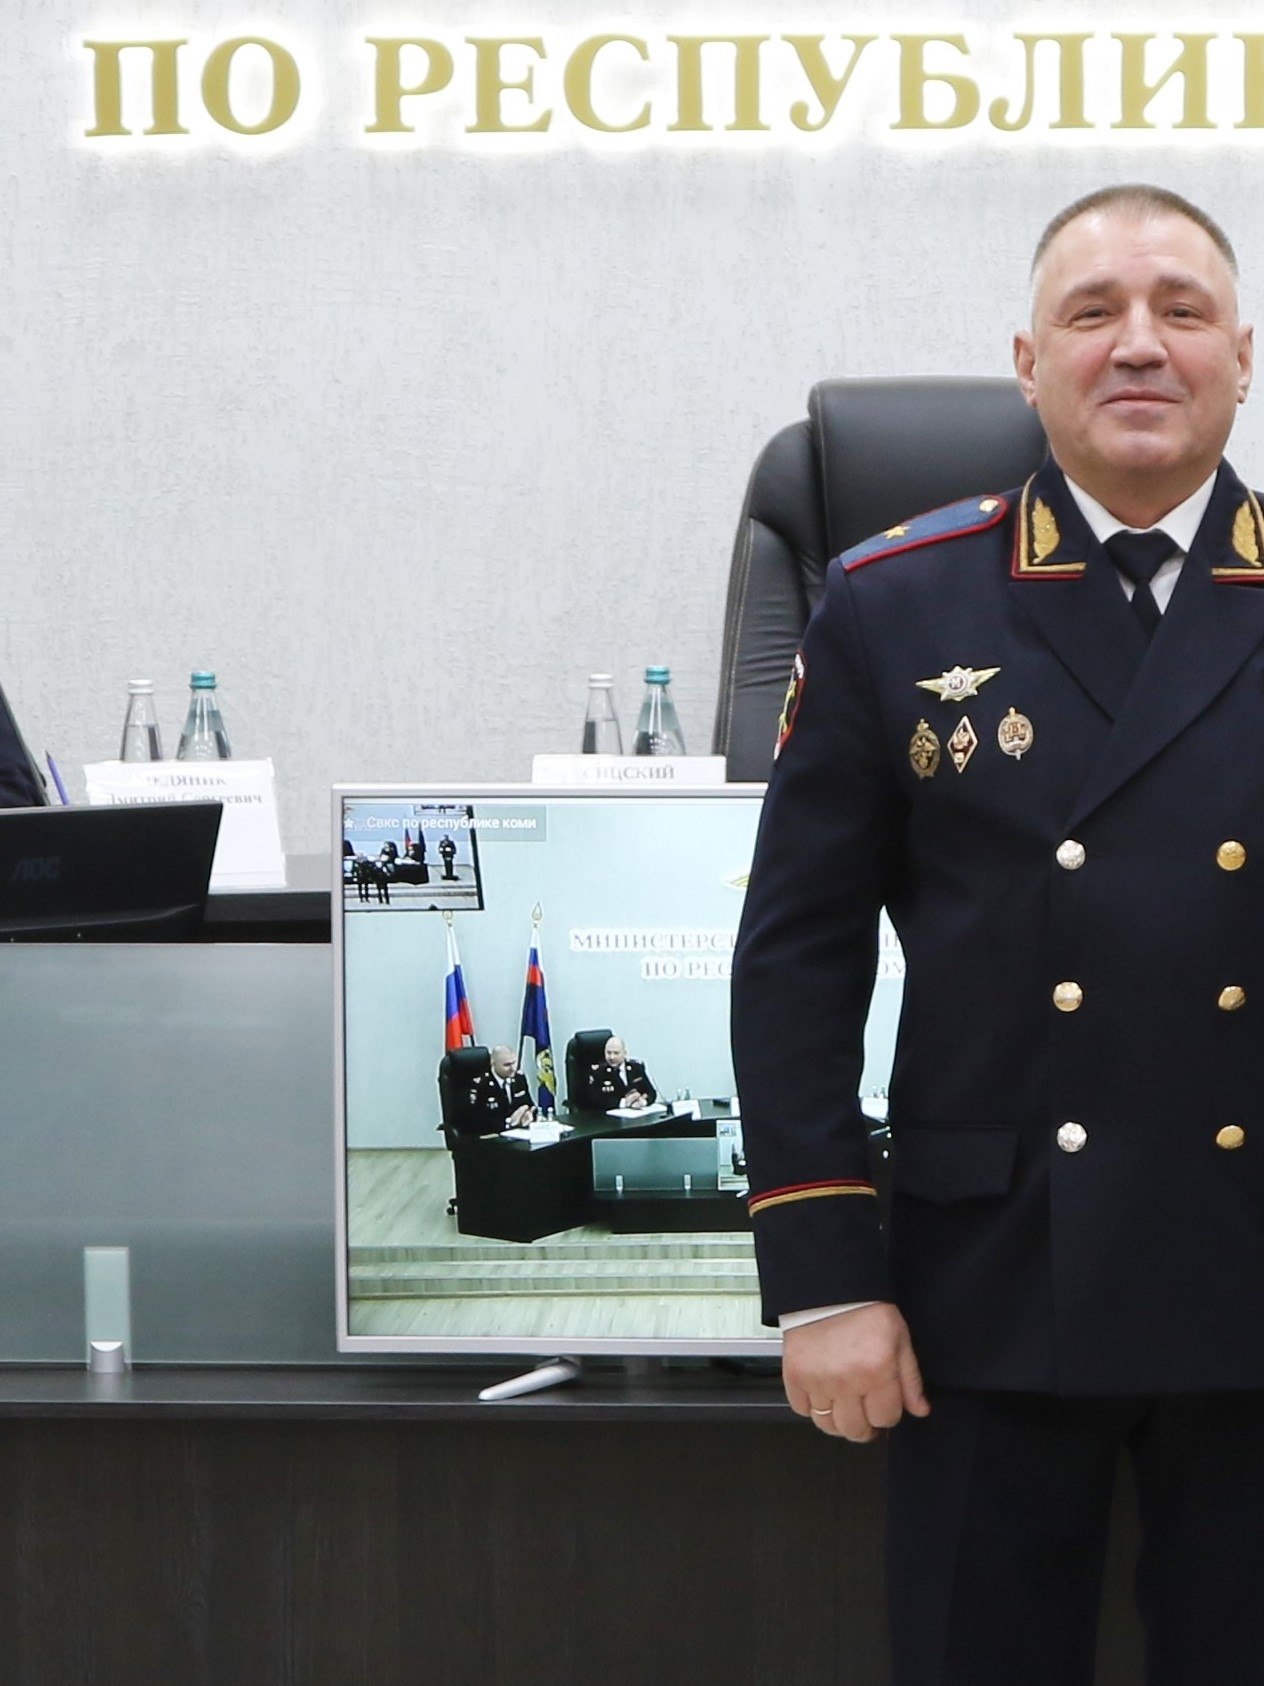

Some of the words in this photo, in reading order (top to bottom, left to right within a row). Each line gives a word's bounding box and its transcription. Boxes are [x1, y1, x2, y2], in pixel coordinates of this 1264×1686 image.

[83, 36, 302, 138] ПО
[402, 818, 419, 829] по
[421, 815, 500, 832] республике
[502, 818, 537, 829] коми
